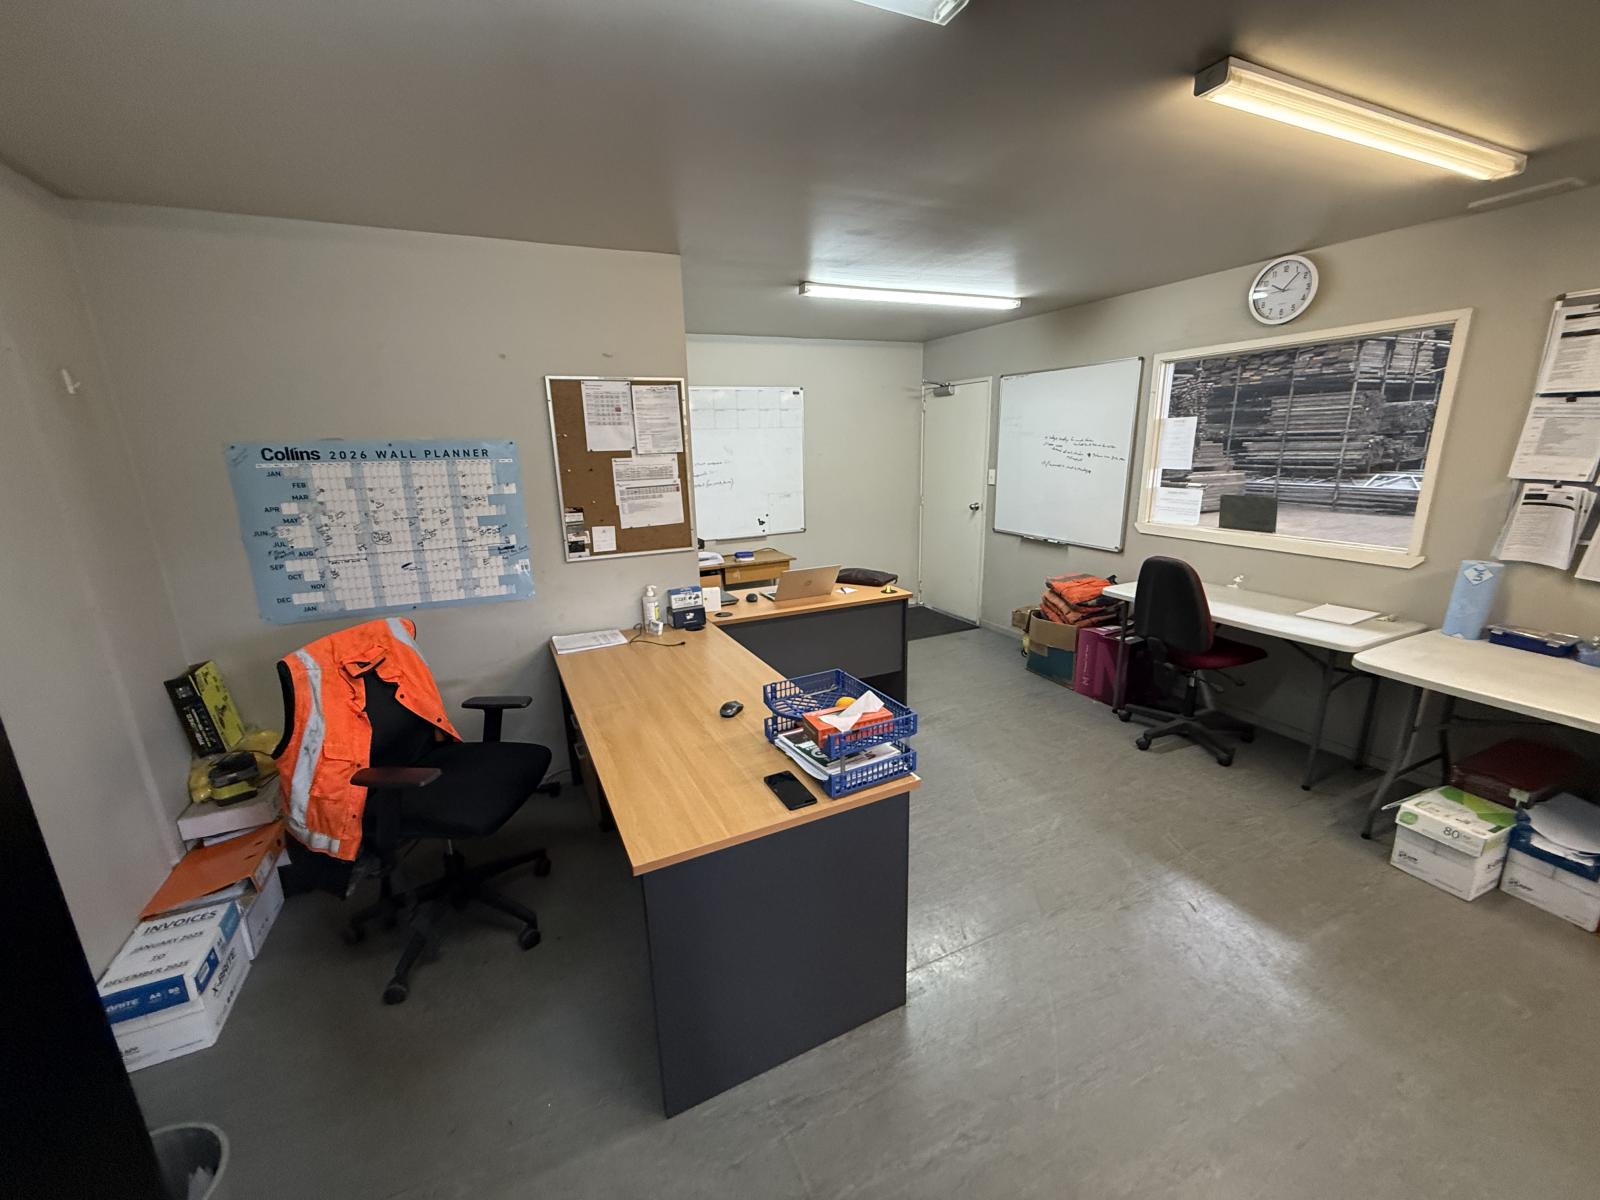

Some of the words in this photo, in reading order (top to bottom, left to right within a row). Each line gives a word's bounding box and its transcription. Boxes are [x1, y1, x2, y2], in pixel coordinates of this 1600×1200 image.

[260, 446, 321, 461] Collins
[329, 450, 368, 460] 2026
[375, 449, 417, 459] WALL
[424, 448, 489, 458] PLANNER
[269, 563, 285, 571] SEP
[1442, 826, 1460, 839] 80
[143, 910, 217, 936] INVOICES
